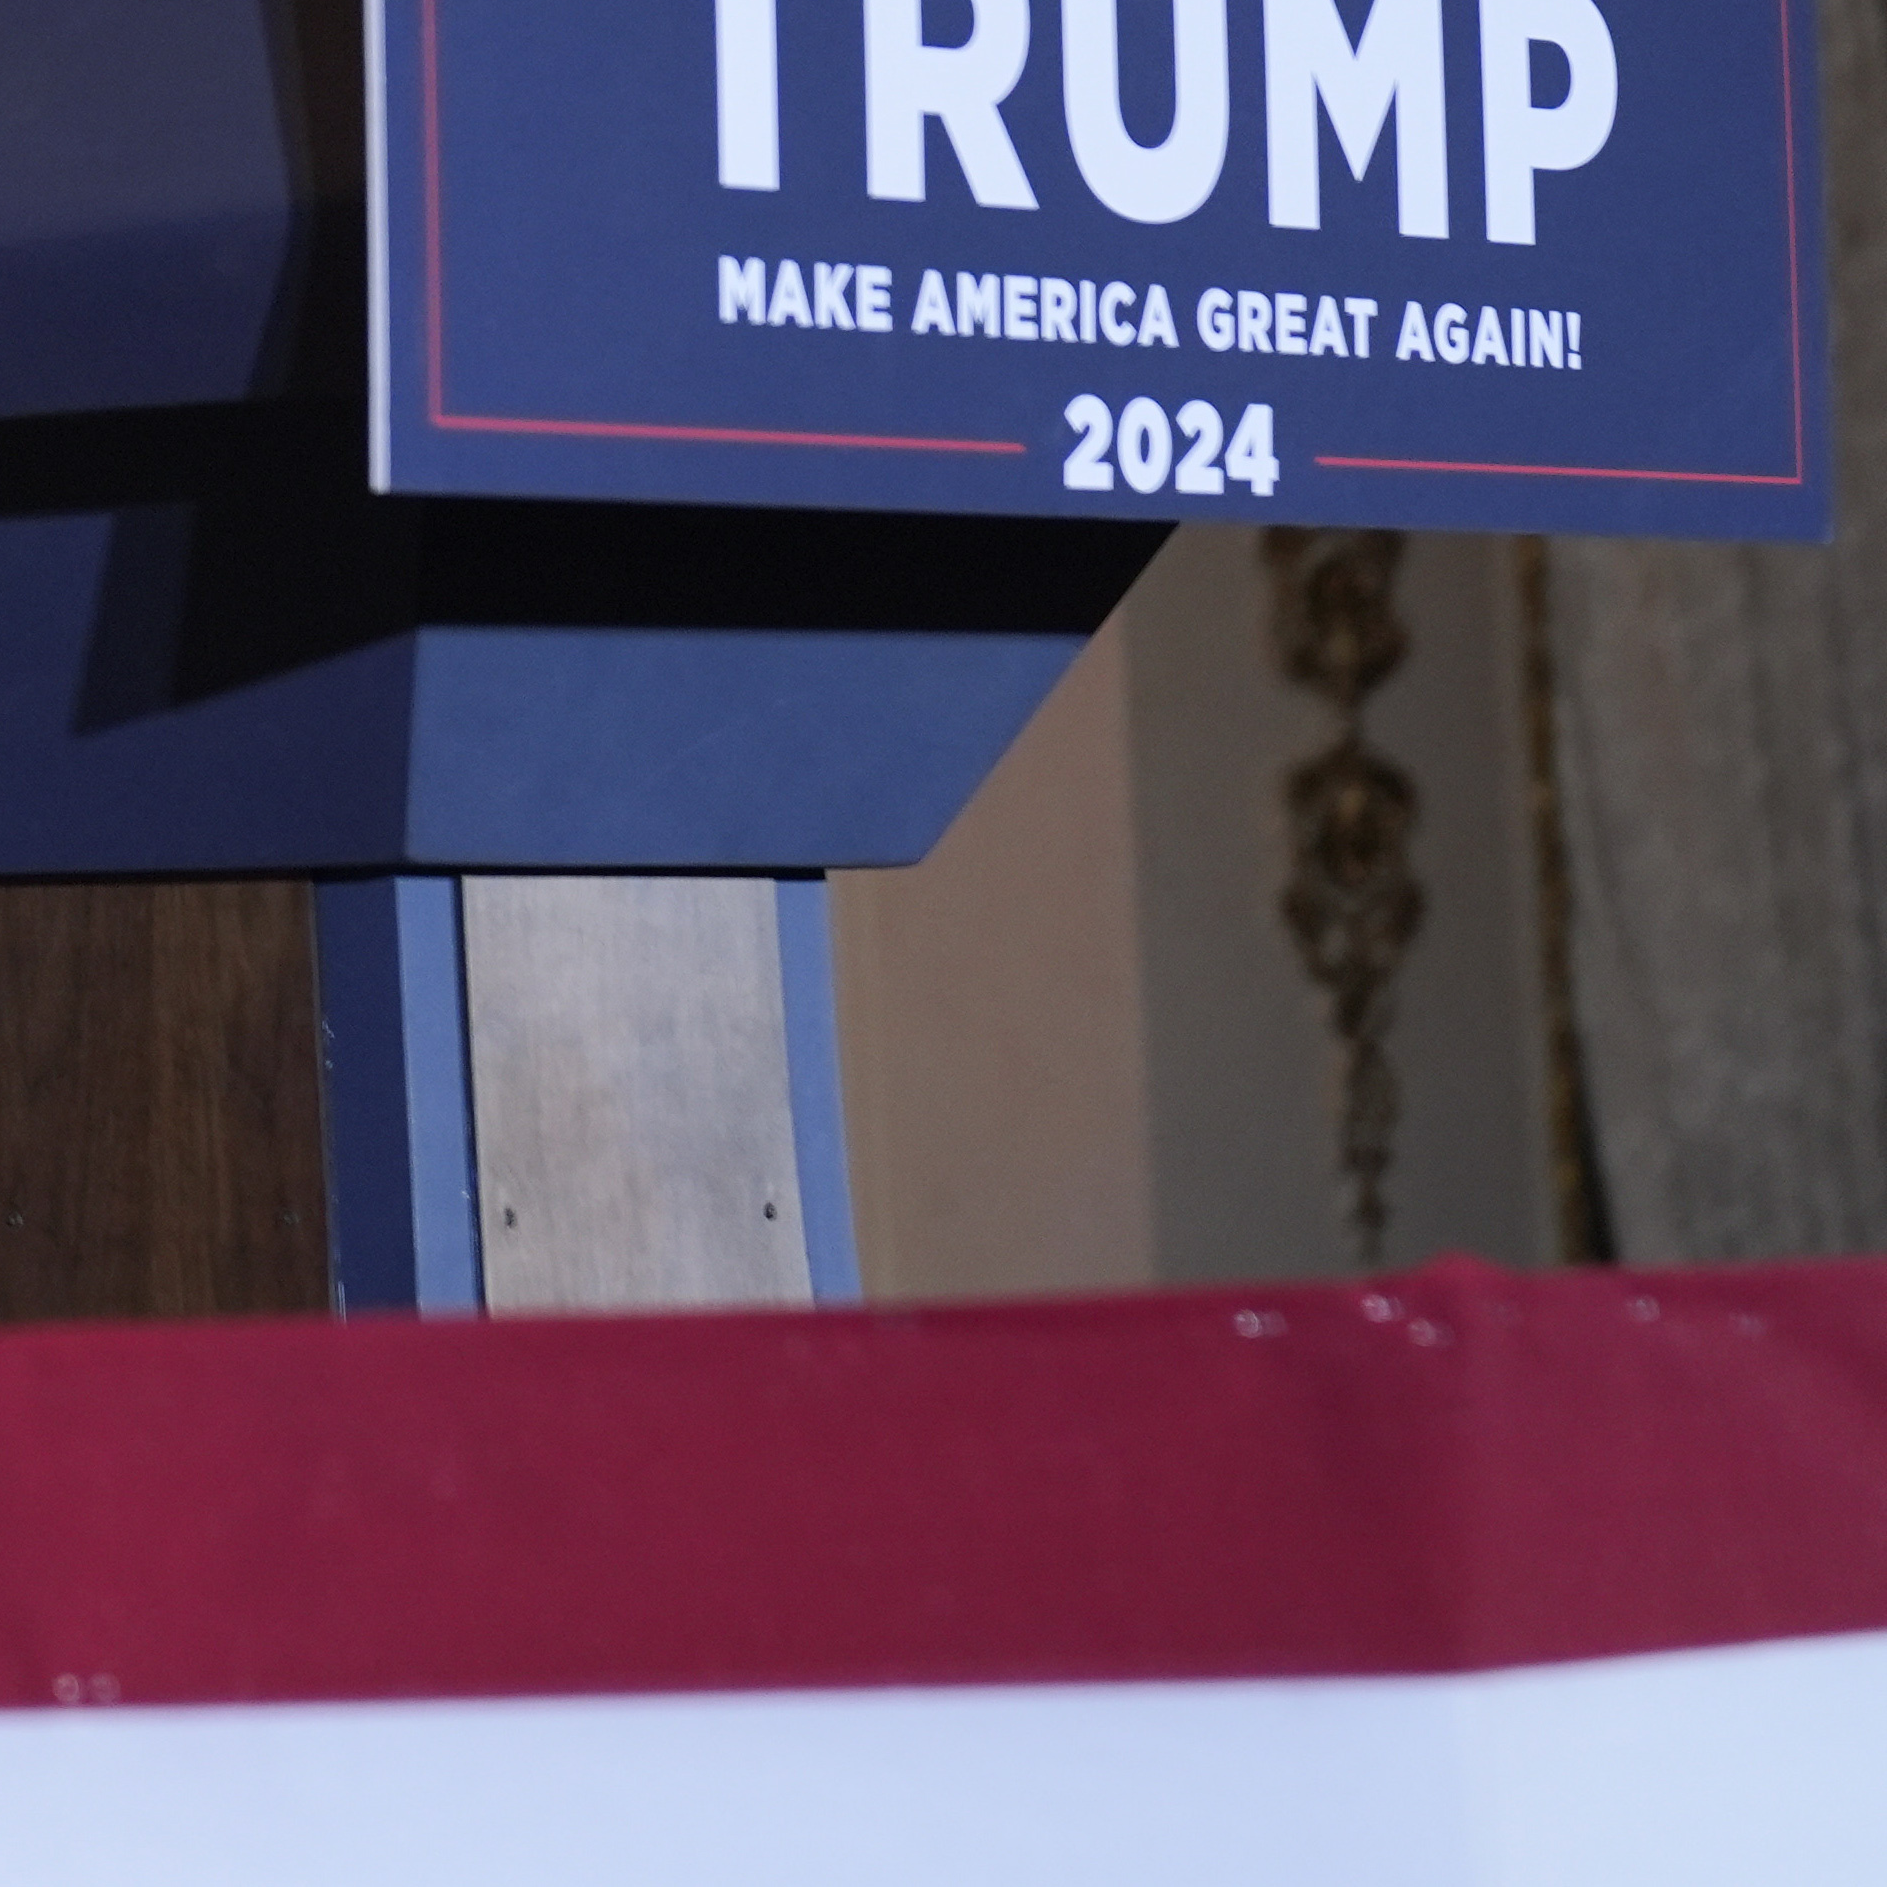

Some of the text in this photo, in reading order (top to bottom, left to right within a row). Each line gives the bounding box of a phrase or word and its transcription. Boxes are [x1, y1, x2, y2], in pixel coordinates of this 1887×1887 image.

[717, 255, 1583, 371] MAKE AMERICA GREAT AGAIN!
[1062, 393, 1280, 498] 2024
